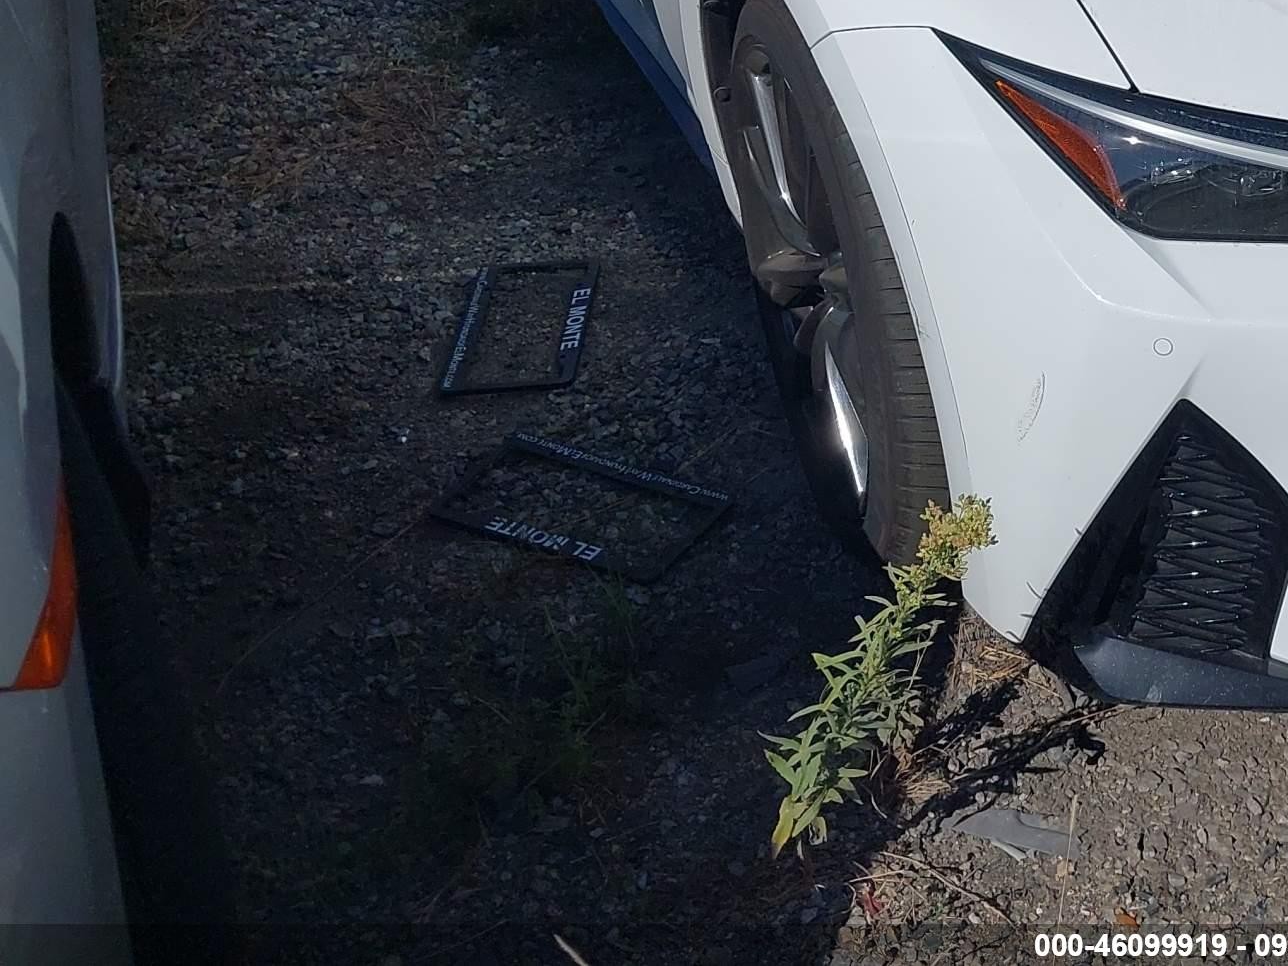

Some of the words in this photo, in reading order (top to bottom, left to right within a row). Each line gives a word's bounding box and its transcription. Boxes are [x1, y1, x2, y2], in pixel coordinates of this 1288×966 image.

[571, 287, 591, 305] EL
[560, 305, 587, 351] MONTE
[484, 515, 570, 550] MONTE
[571, 540, 603, 562] EL
